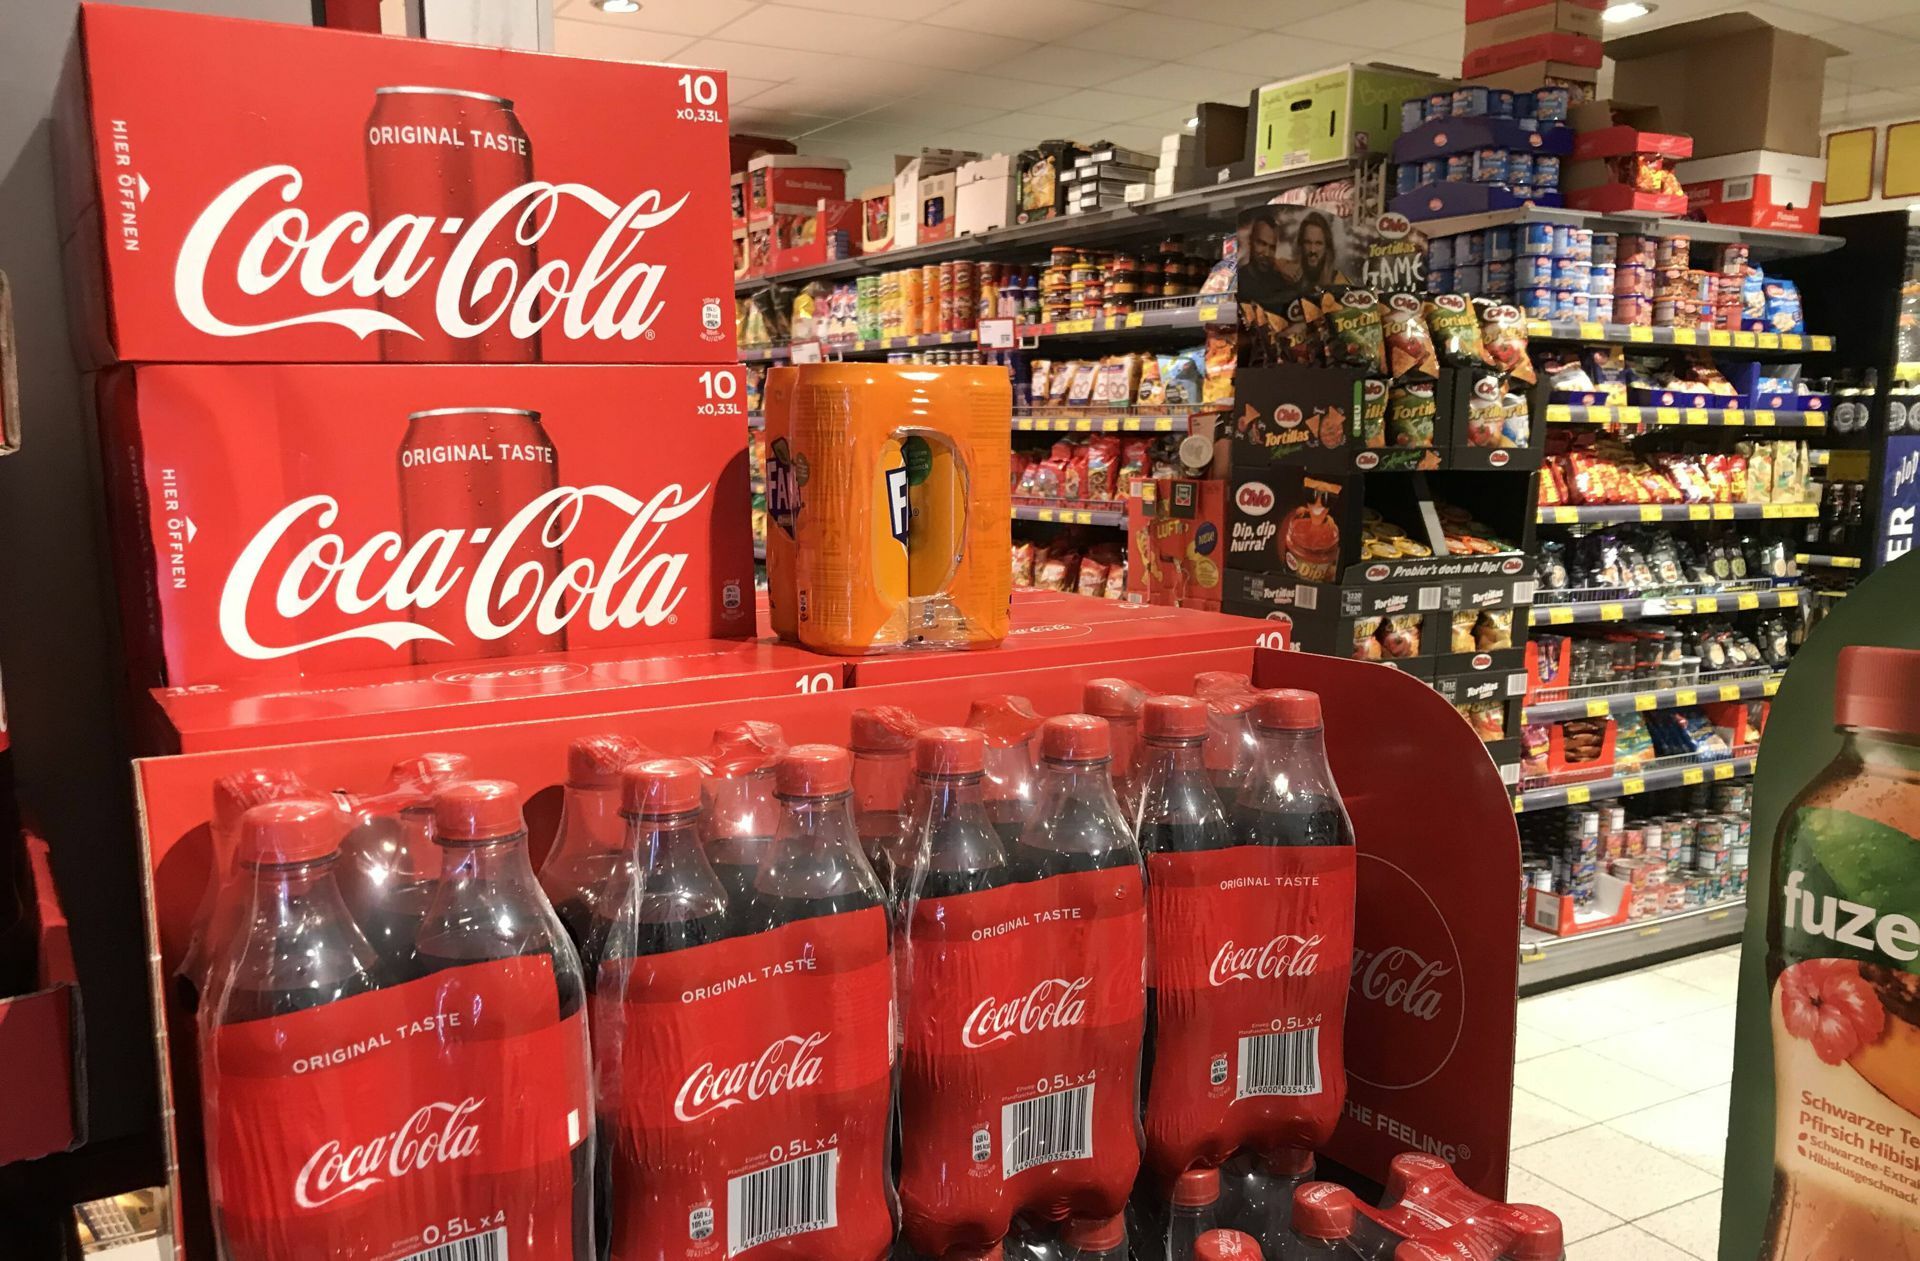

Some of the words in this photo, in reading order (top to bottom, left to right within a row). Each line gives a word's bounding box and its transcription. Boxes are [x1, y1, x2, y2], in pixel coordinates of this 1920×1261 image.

[678, 74, 718, 106] 10
[676, 108, 724, 123] x0,33L
[112, 119, 131, 168] HIER
[369, 125, 465, 148] ORIGINAL
[471, 129, 527, 157] TASTE
[116, 173, 141, 252] ÖFFNEN
[174, 164, 691, 342] Coca-Cola
[698, 371, 738, 399] 10
[697, 403, 743, 416] x0,33L
[1354, 404, 1362, 430] NEU
[1265, 428, 1311, 448] Tortillas
[402, 443, 494, 468] ORIGINAL
[499, 443, 554, 465] TASTE
[162, 468, 178, 512] HIER
[1239, 487, 1272, 508] Chio
[1232, 522, 1256, 540] Dip,
[1256, 520, 1277, 540] dip
[166, 518, 188, 590] ÖFFNEN
[1231, 537, 1267, 553] hurra!
[219, 482, 711, 660] Coca-Cola
[1393, 564, 1438, 578] Probier's
[1439, 563, 1461, 575] doch
[1462, 561, 1479, 574] mit
[1479, 561, 1500, 574] Dip!
[1263, 587, 1296, 599] Tortillas
[1375, 595, 1409, 610] Tortillas
[1472, 589, 1504, 604] Tortillas
[1255, 631, 1285, 651] 10
[795, 672, 835, 694] 10
[1467, 682, 1499, 697] Tortillas
[1220, 876, 1271, 891] ORIGINAL
[1275, 876, 1320, 887] TASTE
[971, 916, 1030, 941] ORIGINAL
[1034, 907, 1081, 923] TASTE
[1783, 870, 1920, 962] fuze
[1209, 934, 1326, 987] Coca-Cola
[681, 971, 757, 1004] ORIGINAL
[762, 957, 817, 980] TASTE
[962, 976, 1093, 1049] Coca-Cola
[1270, 1016, 1305, 1032] 0,5L
[292, 1032, 392, 1074] ORIGINAL
[396, 1012, 461, 1040] TASTE
[674, 1030, 832, 1122] Coca-Cola
[1036, 1073, 1074, 1094] 0,5L
[1801, 1090, 1895, 1138] Schwarzer
[1800, 1110, 1865, 1150] Pfirsich
[294, 1096, 487, 1209] Coca-Cola
[769, 1138, 813, 1162] 0,5L
[1047, 1151, 1081, 1162] 035431
[1808, 1150, 1919, 1205] Hibiskusgeschmack
[422, 1216, 476, 1245] 0,5L
